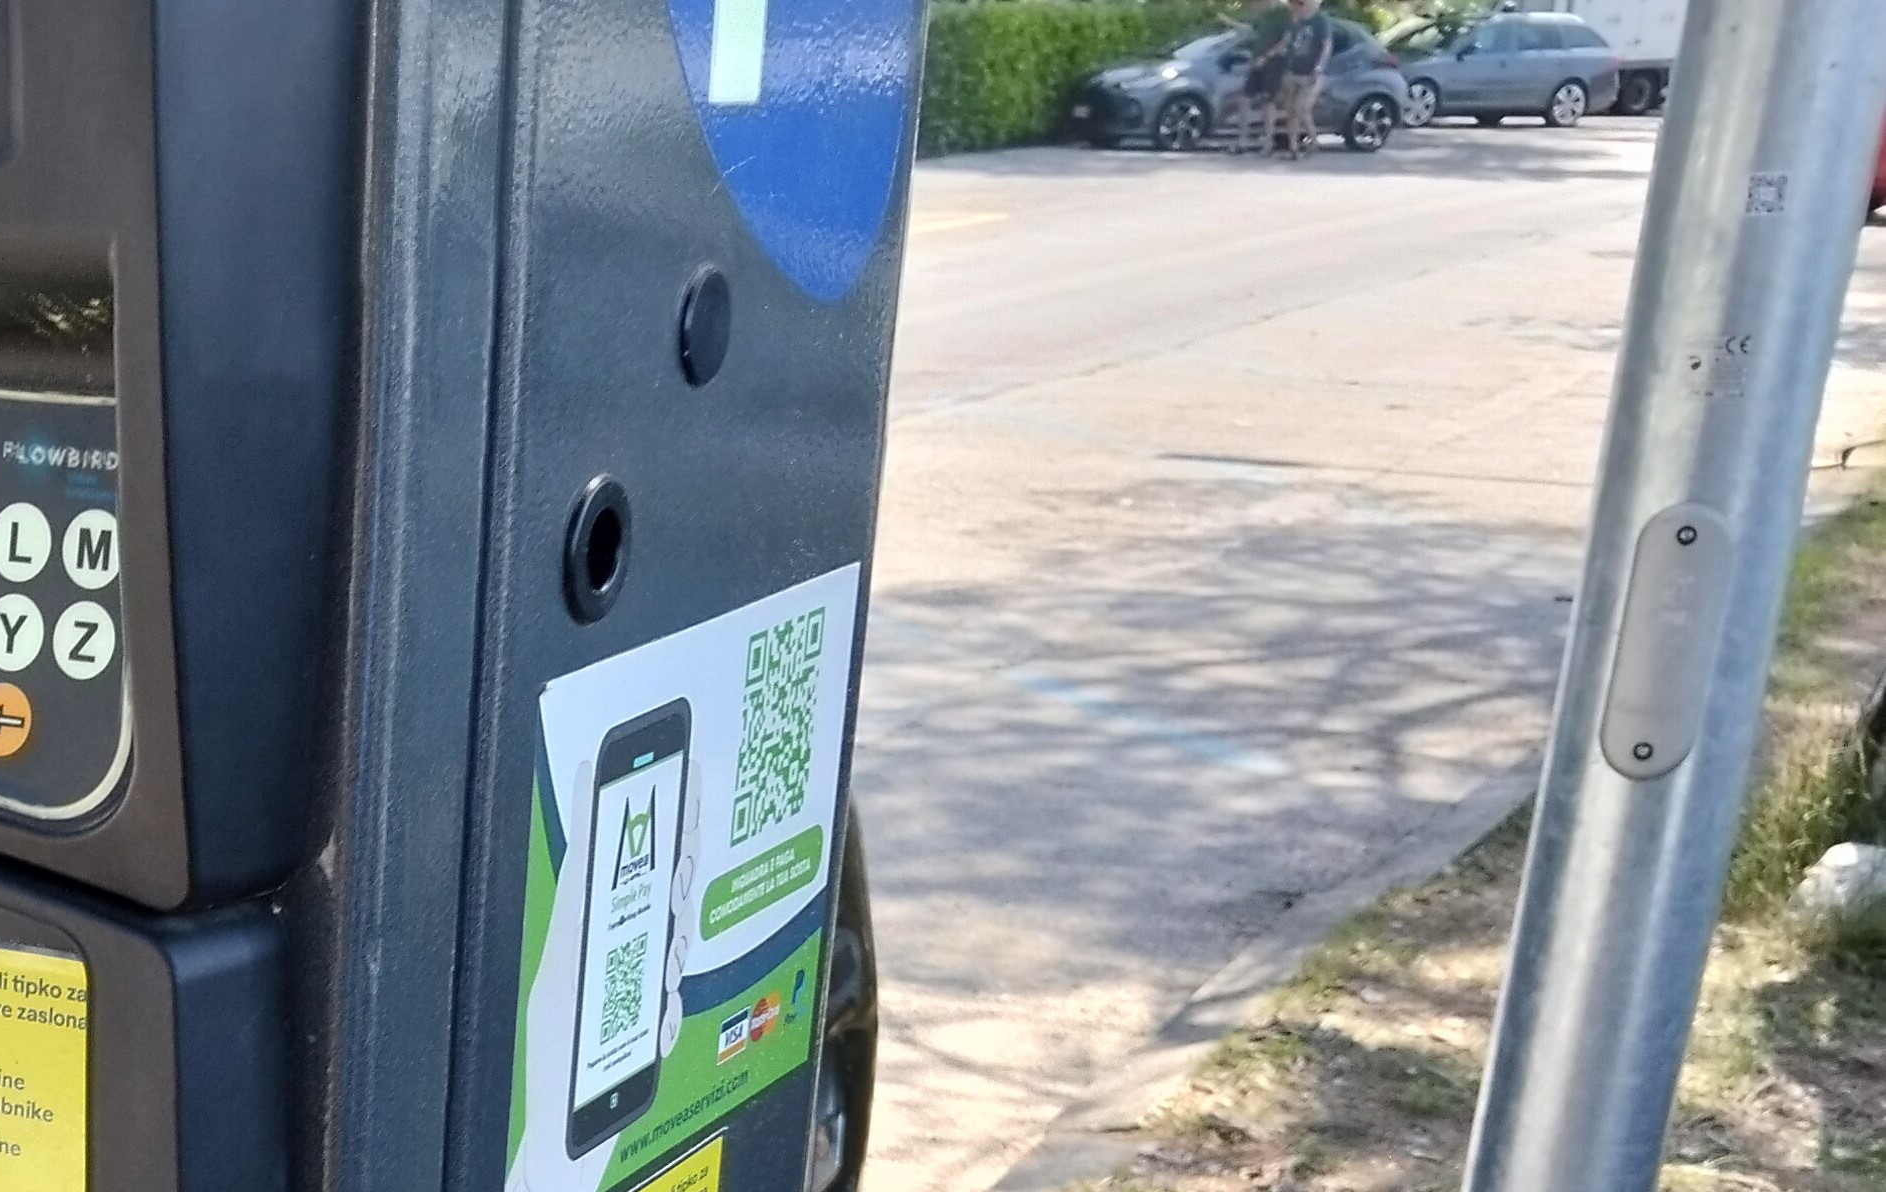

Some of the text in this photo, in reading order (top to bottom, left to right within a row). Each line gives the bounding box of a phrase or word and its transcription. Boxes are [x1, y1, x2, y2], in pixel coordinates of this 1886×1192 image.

[8, 521, 32, 564] L
[76, 527, 113, 572] M
[0, 612, 28, 654] Y
[68, 620, 99, 663] Z
[11, 975, 62, 999] tipko
[67, 985, 86, 1002] za
[725, 1023, 744, 1047] VISA
